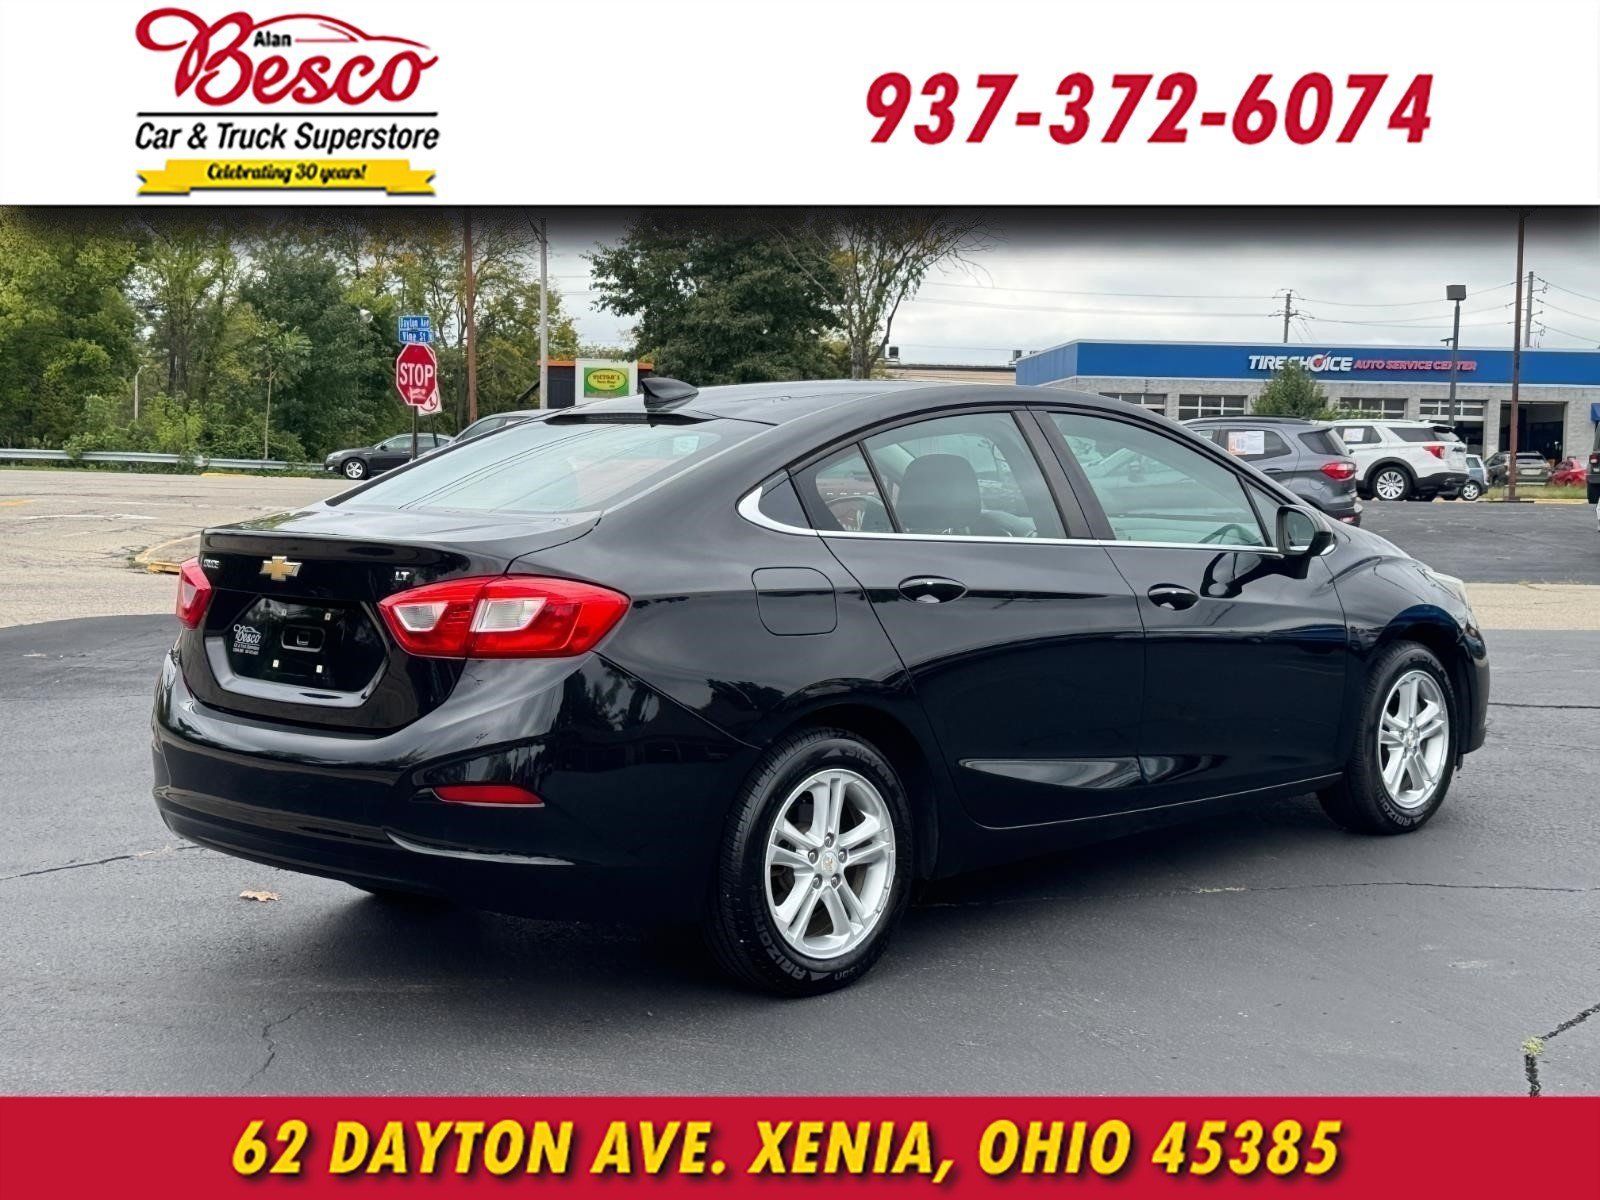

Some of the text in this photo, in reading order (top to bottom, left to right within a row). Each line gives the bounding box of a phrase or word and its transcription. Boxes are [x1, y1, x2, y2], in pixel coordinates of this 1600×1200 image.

[402, 331, 427, 341] Vine St
[1248, 355, 1288, 370] TIRE
[1354, 359, 1385, 370] AUTO
[1386, 360, 1433, 371] SERVICE
[400, 362, 434, 387] STOP
[395, 571, 410, 581] LT
